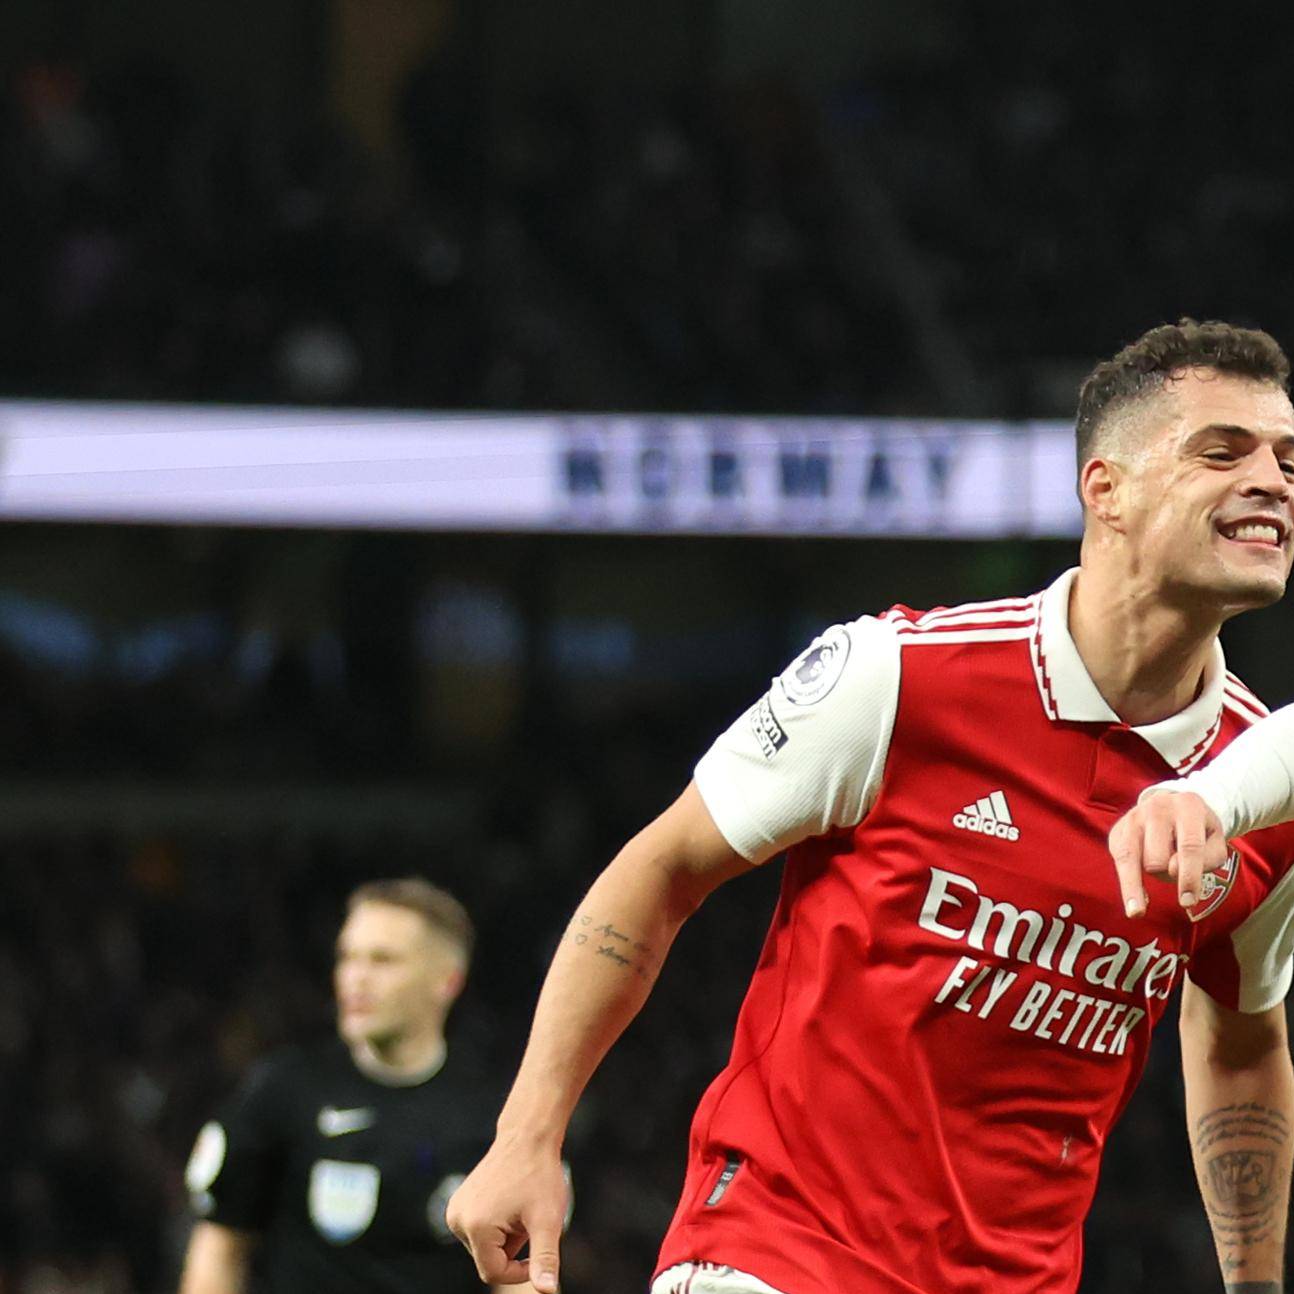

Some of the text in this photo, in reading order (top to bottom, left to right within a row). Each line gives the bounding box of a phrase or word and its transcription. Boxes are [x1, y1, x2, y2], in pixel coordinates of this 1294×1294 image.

[952, 811, 1020, 842] adidas
[934, 955, 1146, 1057] FLY BETTER
